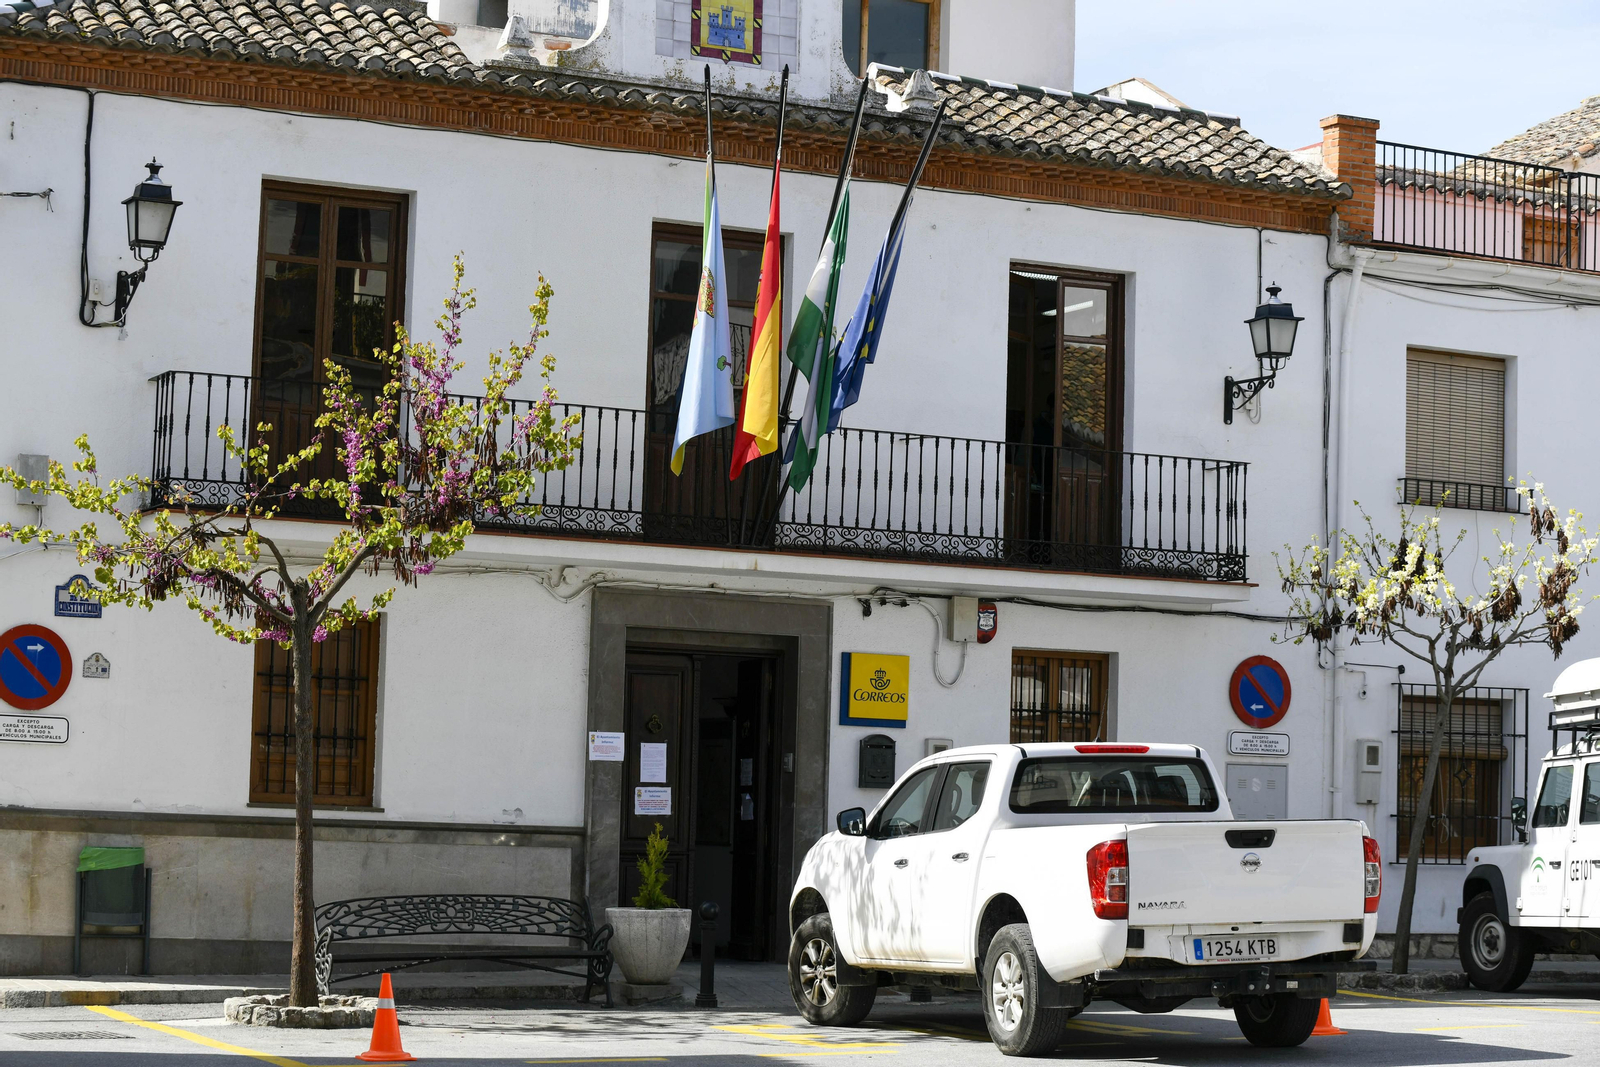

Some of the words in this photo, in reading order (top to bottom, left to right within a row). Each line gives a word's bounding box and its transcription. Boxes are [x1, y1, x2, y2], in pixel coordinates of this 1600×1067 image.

[854, 688, 906, 703] CORREOS
[1570, 860, 1591, 881] GE101
[1138, 901, 1186, 910] NAVARA
[1207, 940, 1242, 956] 1254
[1248, 939, 1276, 954] KTB
